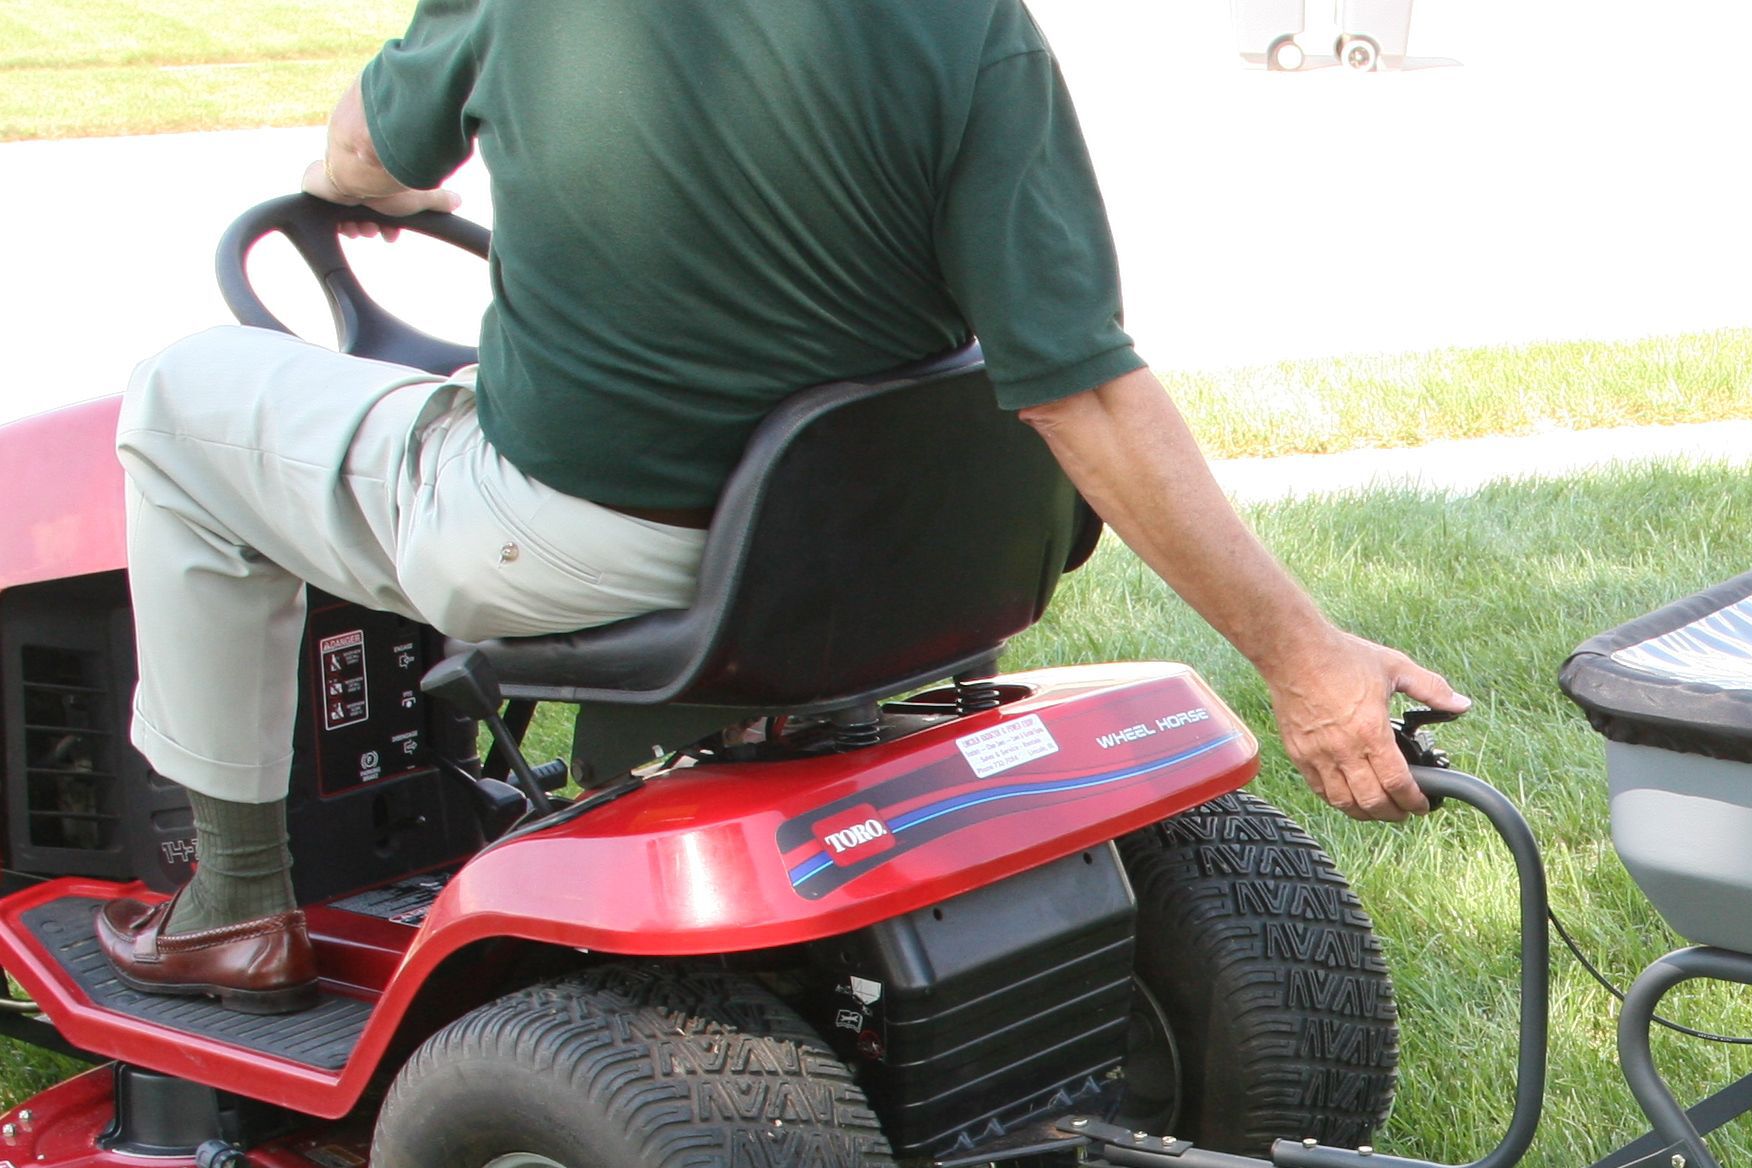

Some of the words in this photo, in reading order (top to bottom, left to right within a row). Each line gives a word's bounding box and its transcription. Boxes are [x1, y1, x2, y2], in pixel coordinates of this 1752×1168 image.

[1096, 724, 1156, 749] WHEEL
[1155, 708, 1208, 731] HORSE
[824, 819, 887, 853] TORO
